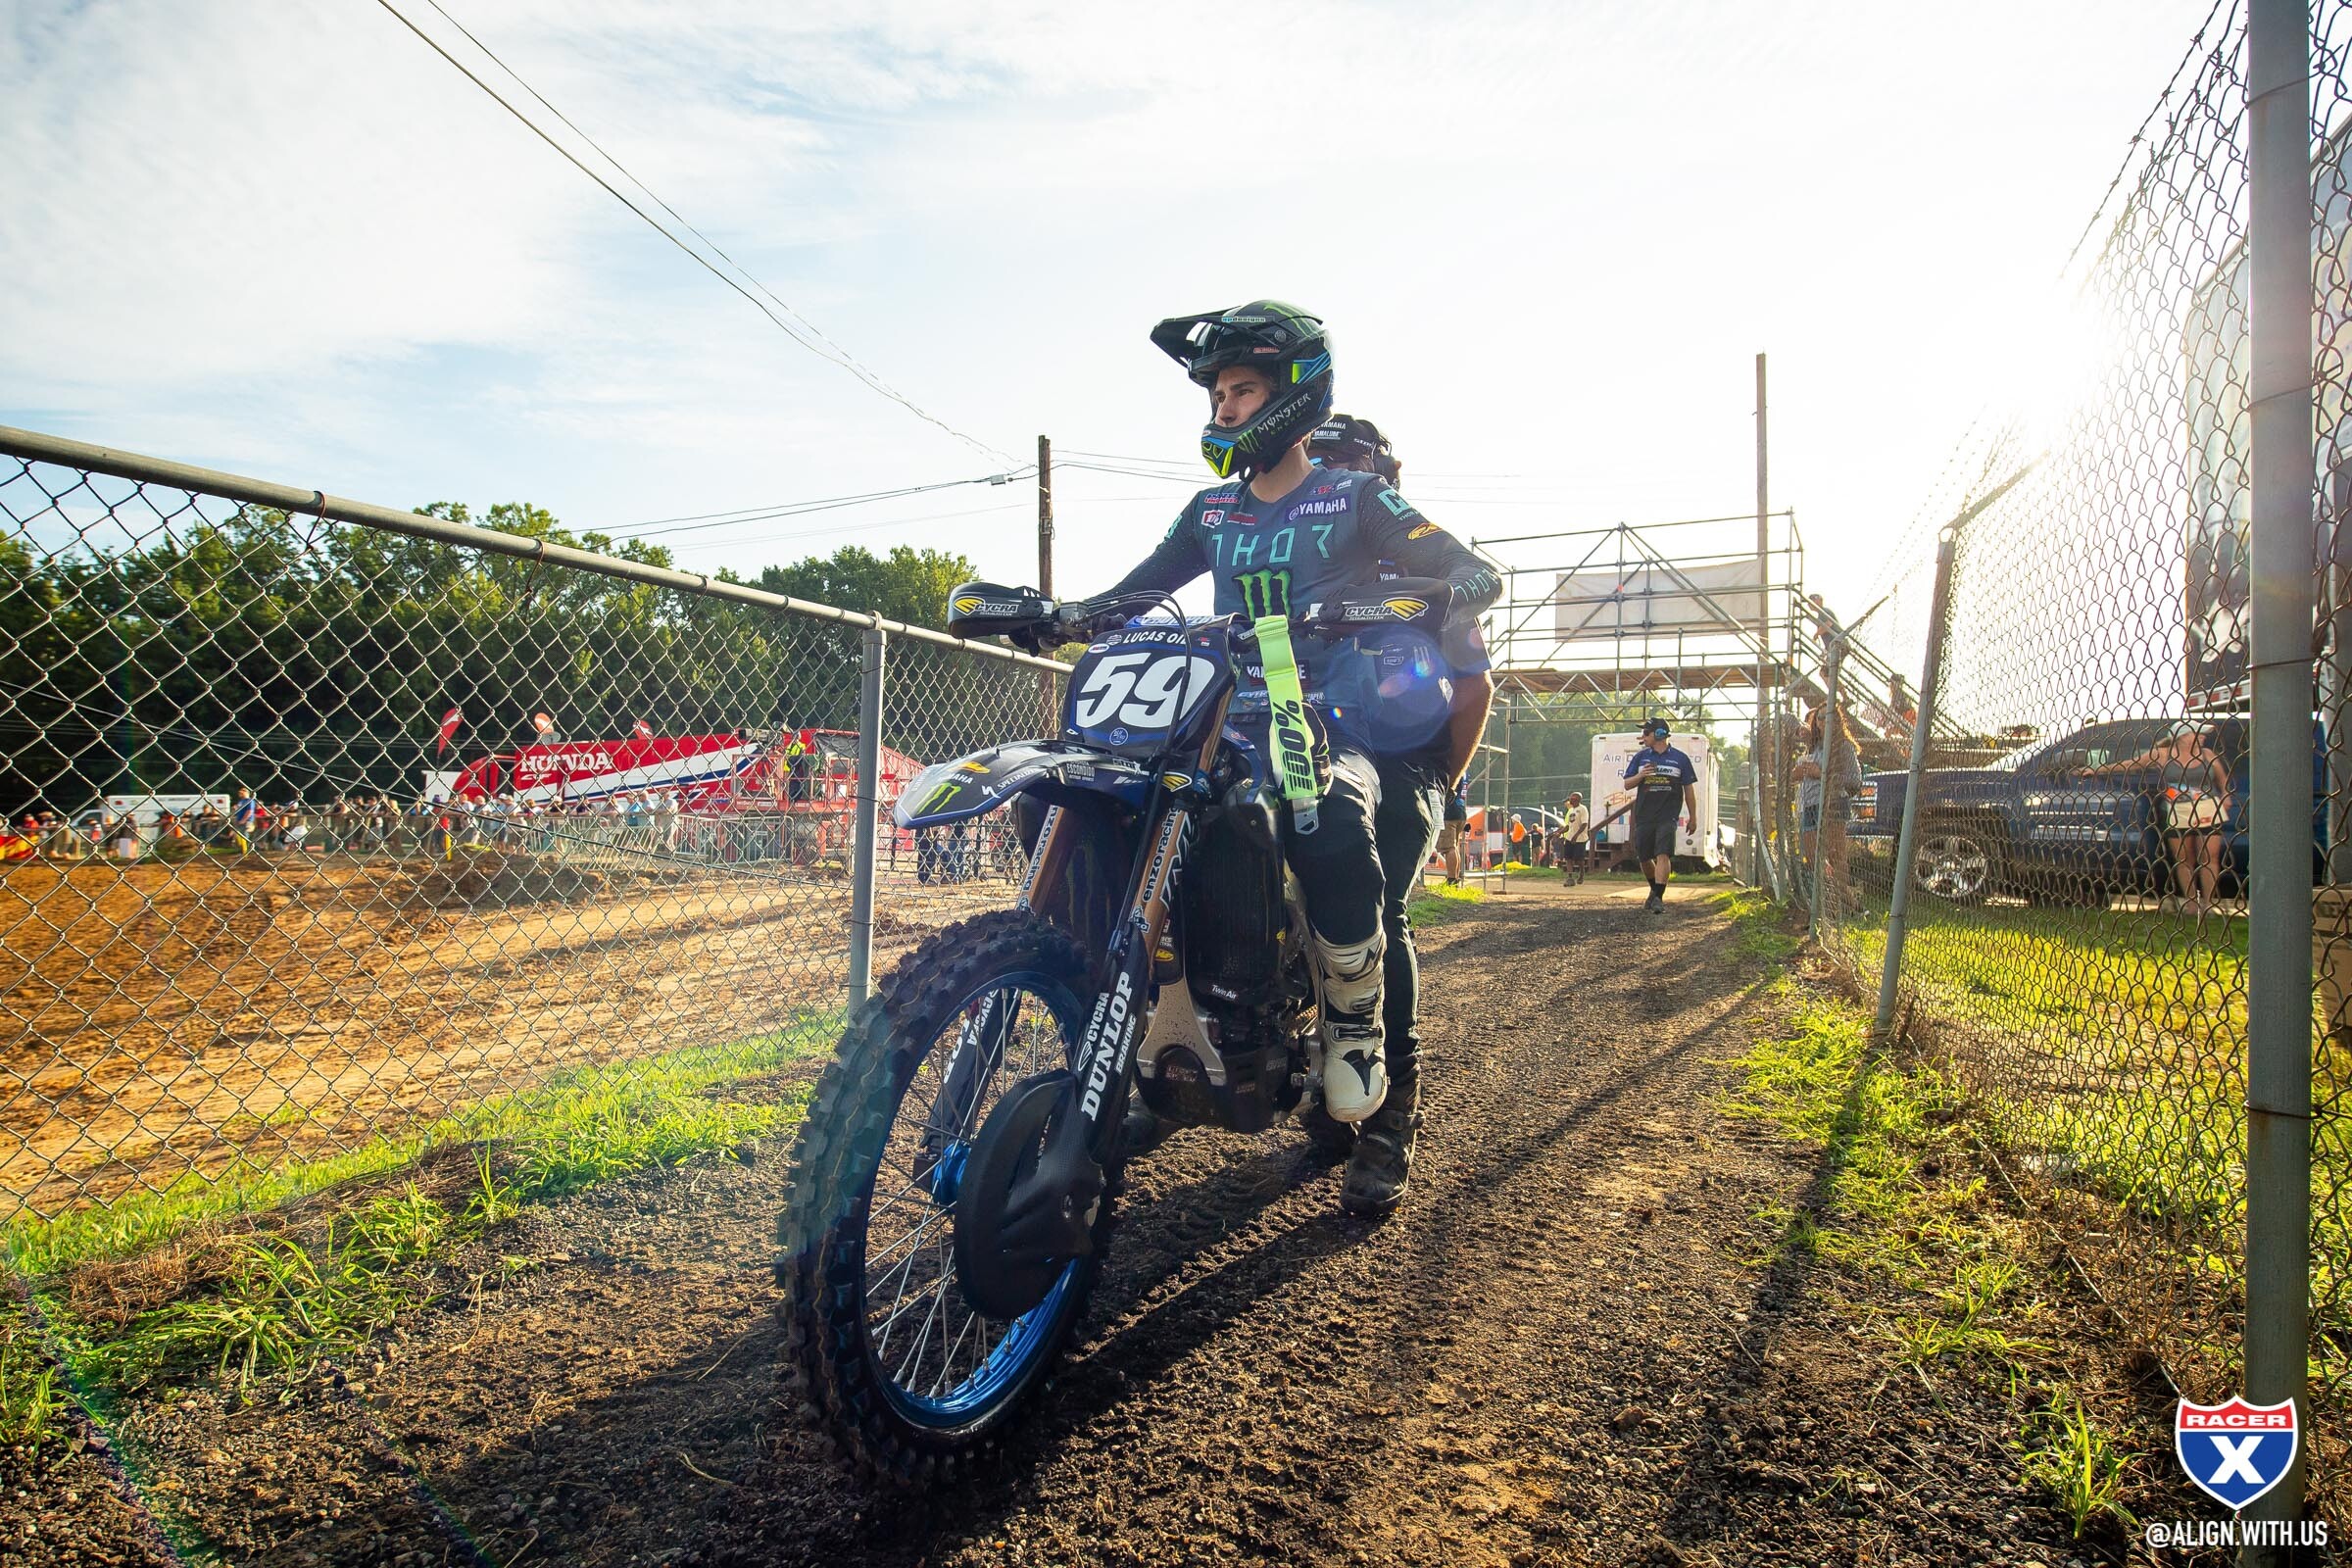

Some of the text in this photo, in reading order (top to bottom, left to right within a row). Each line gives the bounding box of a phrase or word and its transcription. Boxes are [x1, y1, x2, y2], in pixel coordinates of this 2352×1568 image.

[1256, 393, 1311, 434] MONSTER
[1299, 497, 1348, 515] YAMAHA
[974, 603, 1020, 614] CYCRA
[1345, 606, 1394, 616] CYCRA
[1122, 630, 1166, 644] LUCAS
[1166, 632, 1188, 645] OIL
[1076, 652, 1215, 728] 59
[1273, 700, 1314, 793] 100%
[519, 752, 612, 772] HONDA
[1211, 984, 1237, 1000] Twin Air
[1086, 992, 1110, 1043] CYCRA
[1081, 971, 1133, 1122] DUNLOP
[1115, 1013, 1137, 1075] BRAKING
